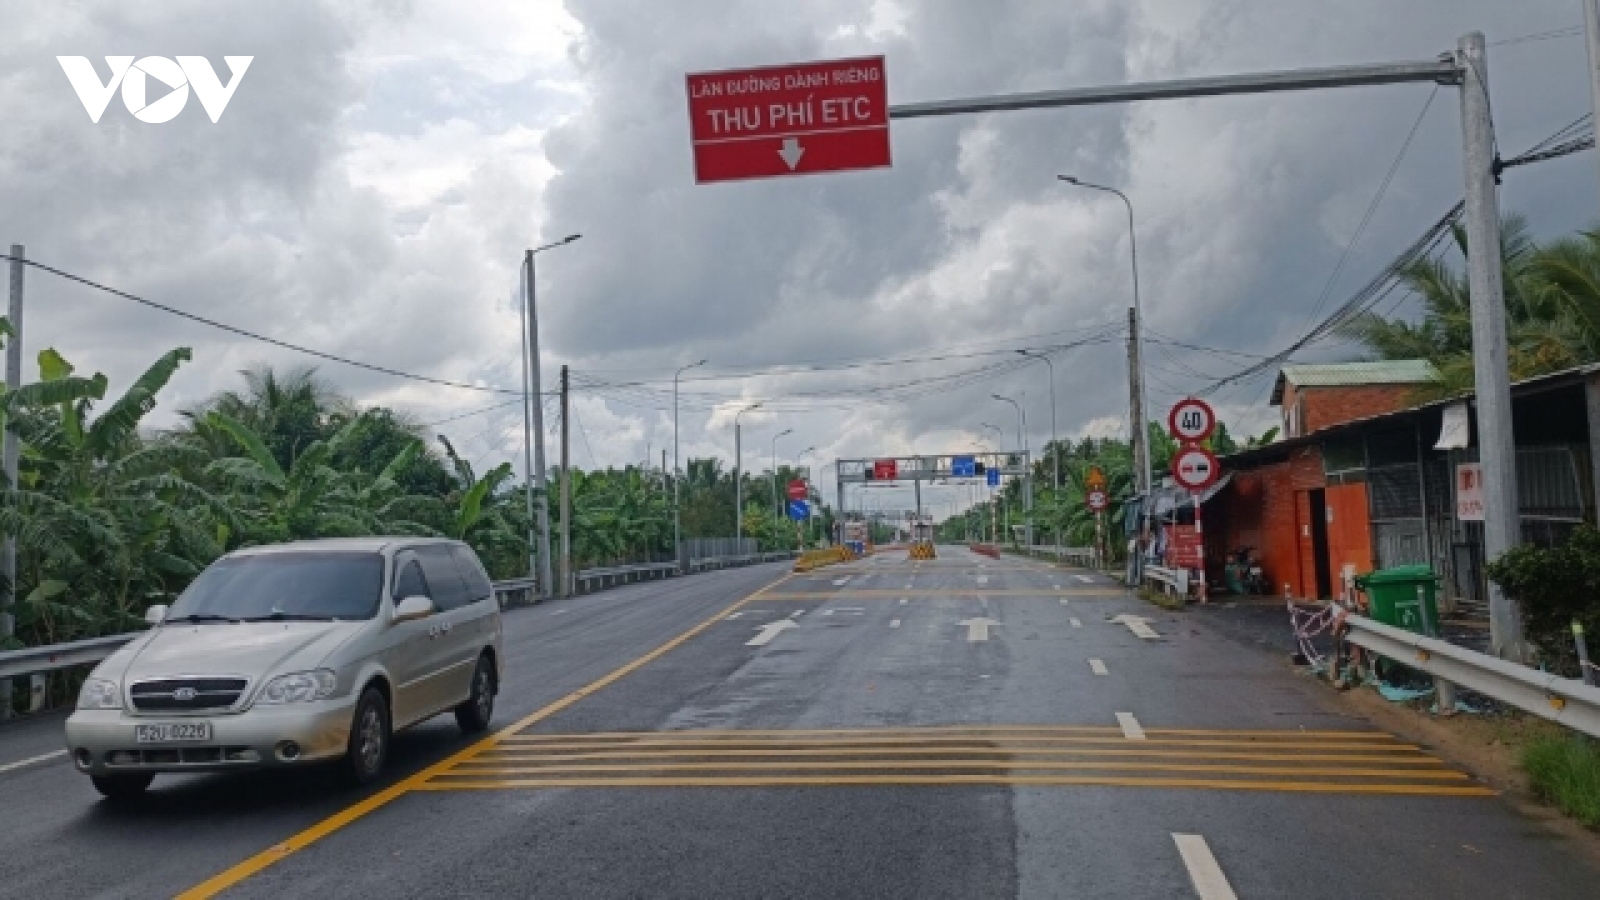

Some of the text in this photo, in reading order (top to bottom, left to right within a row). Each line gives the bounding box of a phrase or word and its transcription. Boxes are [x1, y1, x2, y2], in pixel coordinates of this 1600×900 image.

[692, 79, 723, 98] LÀN
[784, 69, 828, 90] DÀNH
[706, 93, 871, 133] THU PHÍ ETC
[1182, 412, 1201, 430] 40
